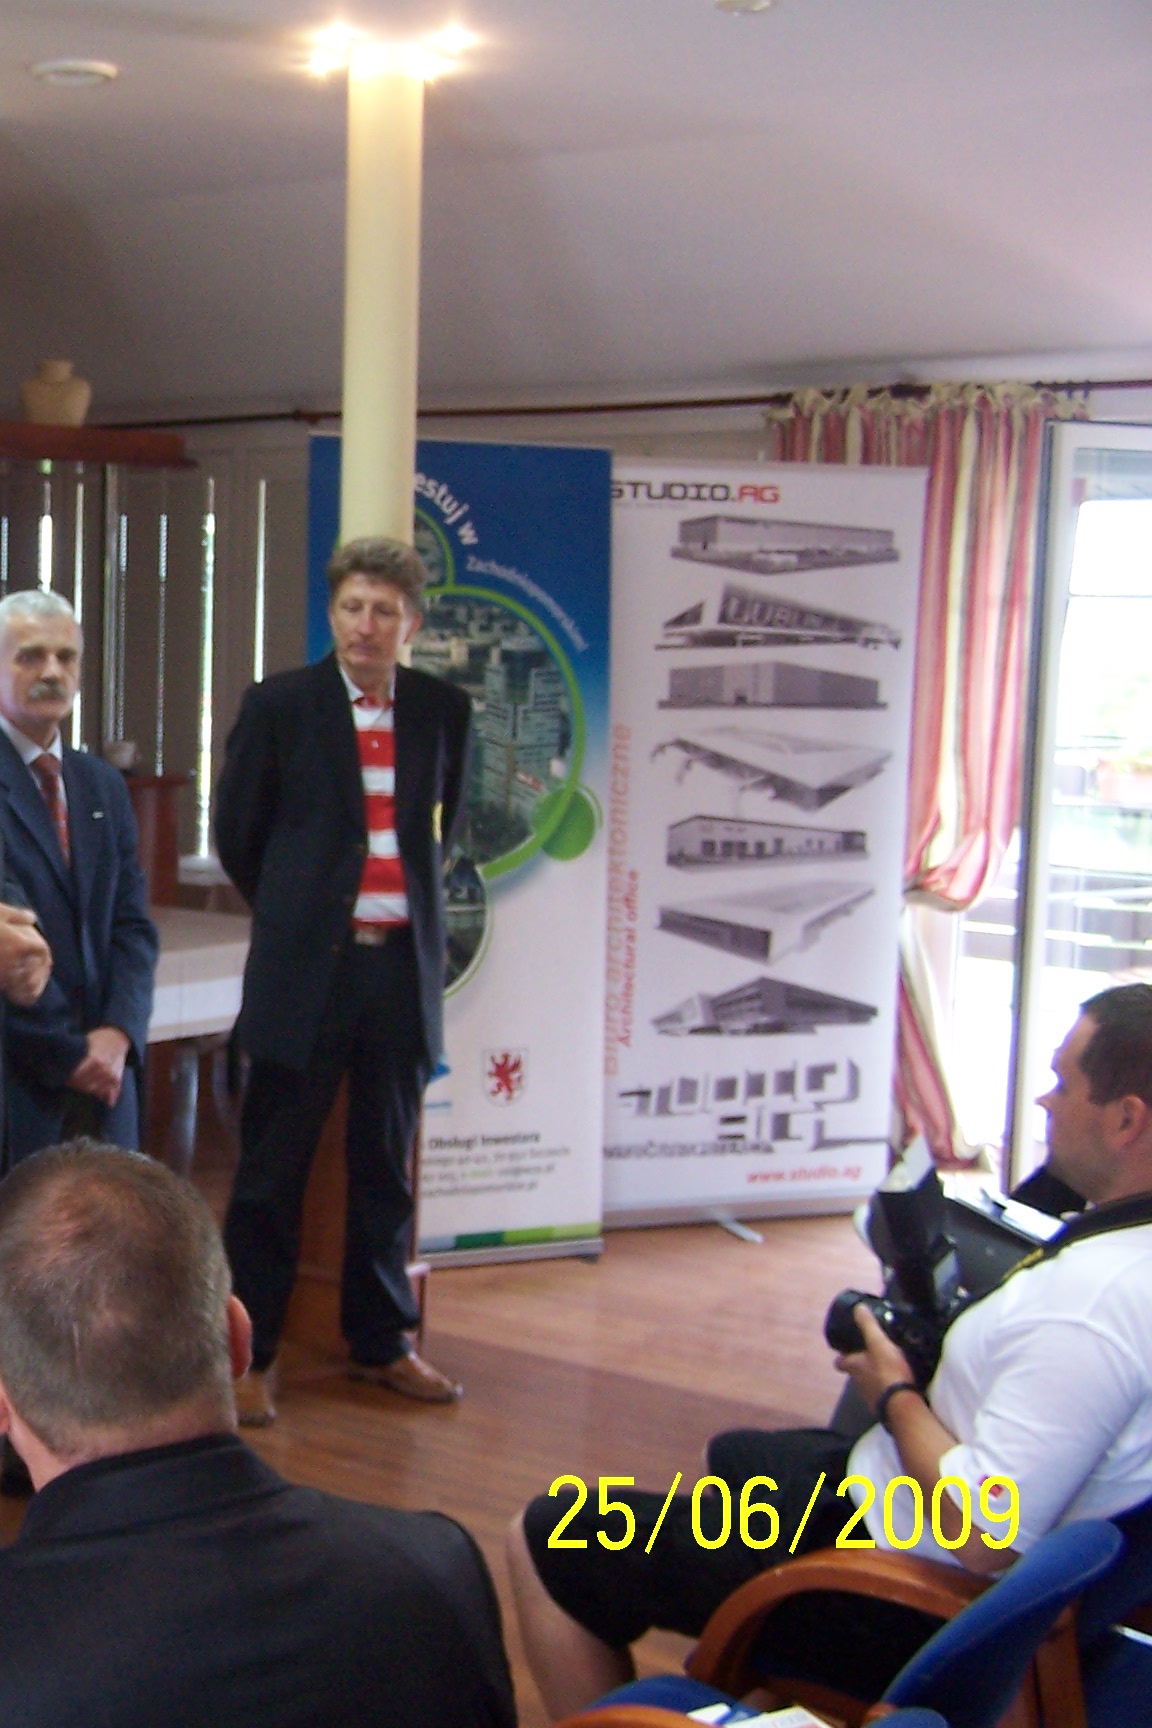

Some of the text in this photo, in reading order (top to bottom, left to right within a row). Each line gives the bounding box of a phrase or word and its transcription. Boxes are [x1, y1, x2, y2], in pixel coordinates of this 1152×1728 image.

[610, 480, 780, 503] STUDIO.AG
[617, 869, 639, 1049] Architectural office
